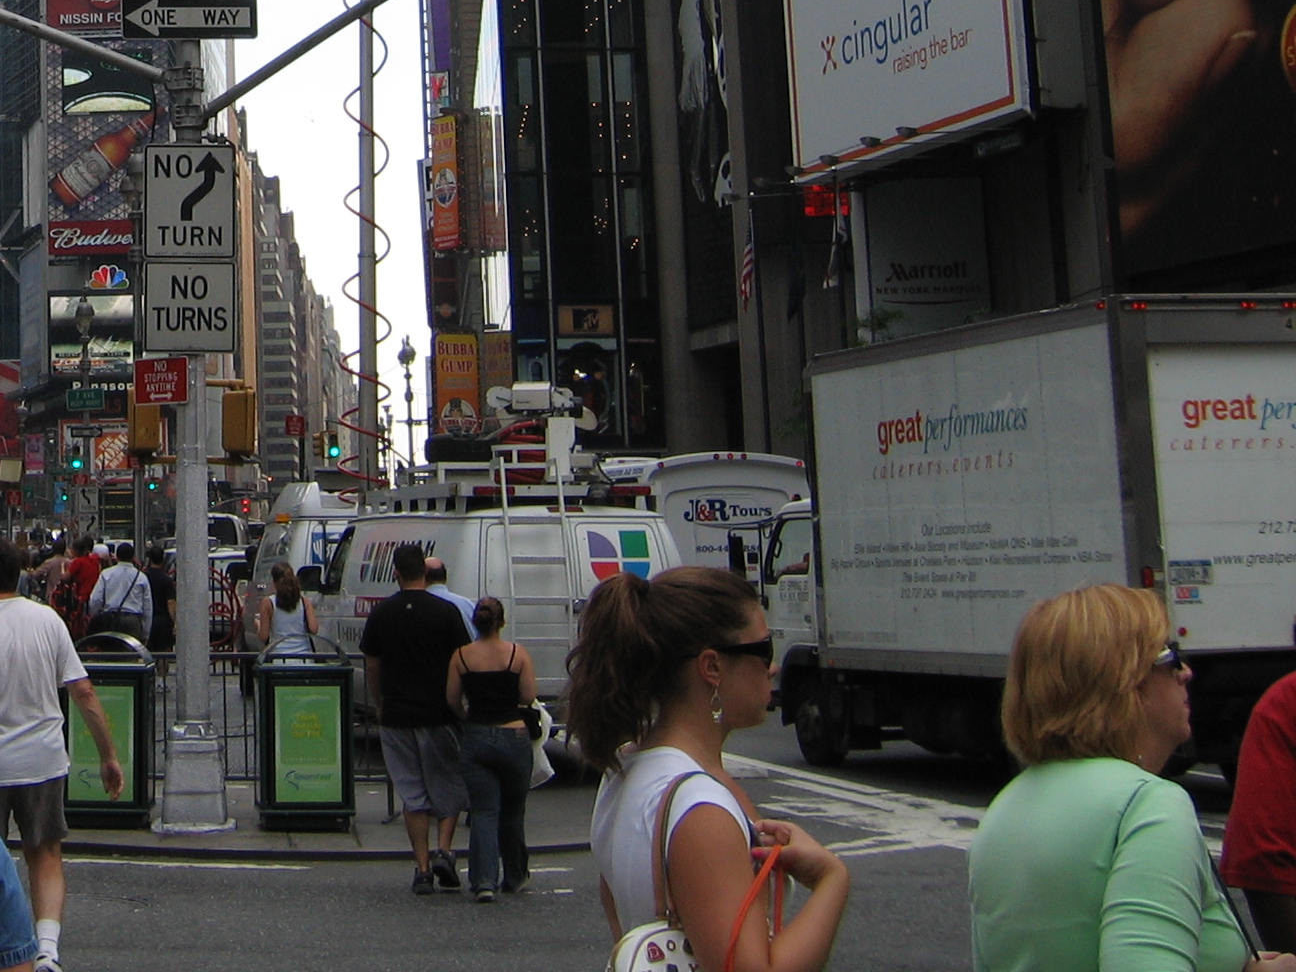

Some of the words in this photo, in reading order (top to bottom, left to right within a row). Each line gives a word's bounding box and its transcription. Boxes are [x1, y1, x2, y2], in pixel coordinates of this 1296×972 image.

[60, 12, 103, 25] NISSIN
[141, 9, 177, 26] ONE
[203, 9, 241, 25] WAY
[893, 46, 927, 75] raising
[929, 34, 948, 59] the
[950, 28, 971, 51] bar
[154, 154, 192, 178] NO
[158, 226, 222, 246] TURN
[886, 260, 967, 283] Marriott
[171, 275, 208, 300] NO
[876, 286, 899, 295] NEW
[903, 285, 929, 294] YORK
[933, 283, 982, 294] MARQUIS
[152, 306, 228, 332] TURNS
[437, 340, 474, 356] BUBBA
[154, 361, 167, 371] NO
[441, 358, 473, 373] GUMP
[144, 372, 178, 383] STOPPING
[146, 383, 177, 392] ANYTIME
[1182, 394, 1257, 428] great
[877, 409, 923, 455] great
[923, 404, 1028, 454] performances
[683, 499, 730, 522] J&R
[730, 504, 772, 517] Tours
